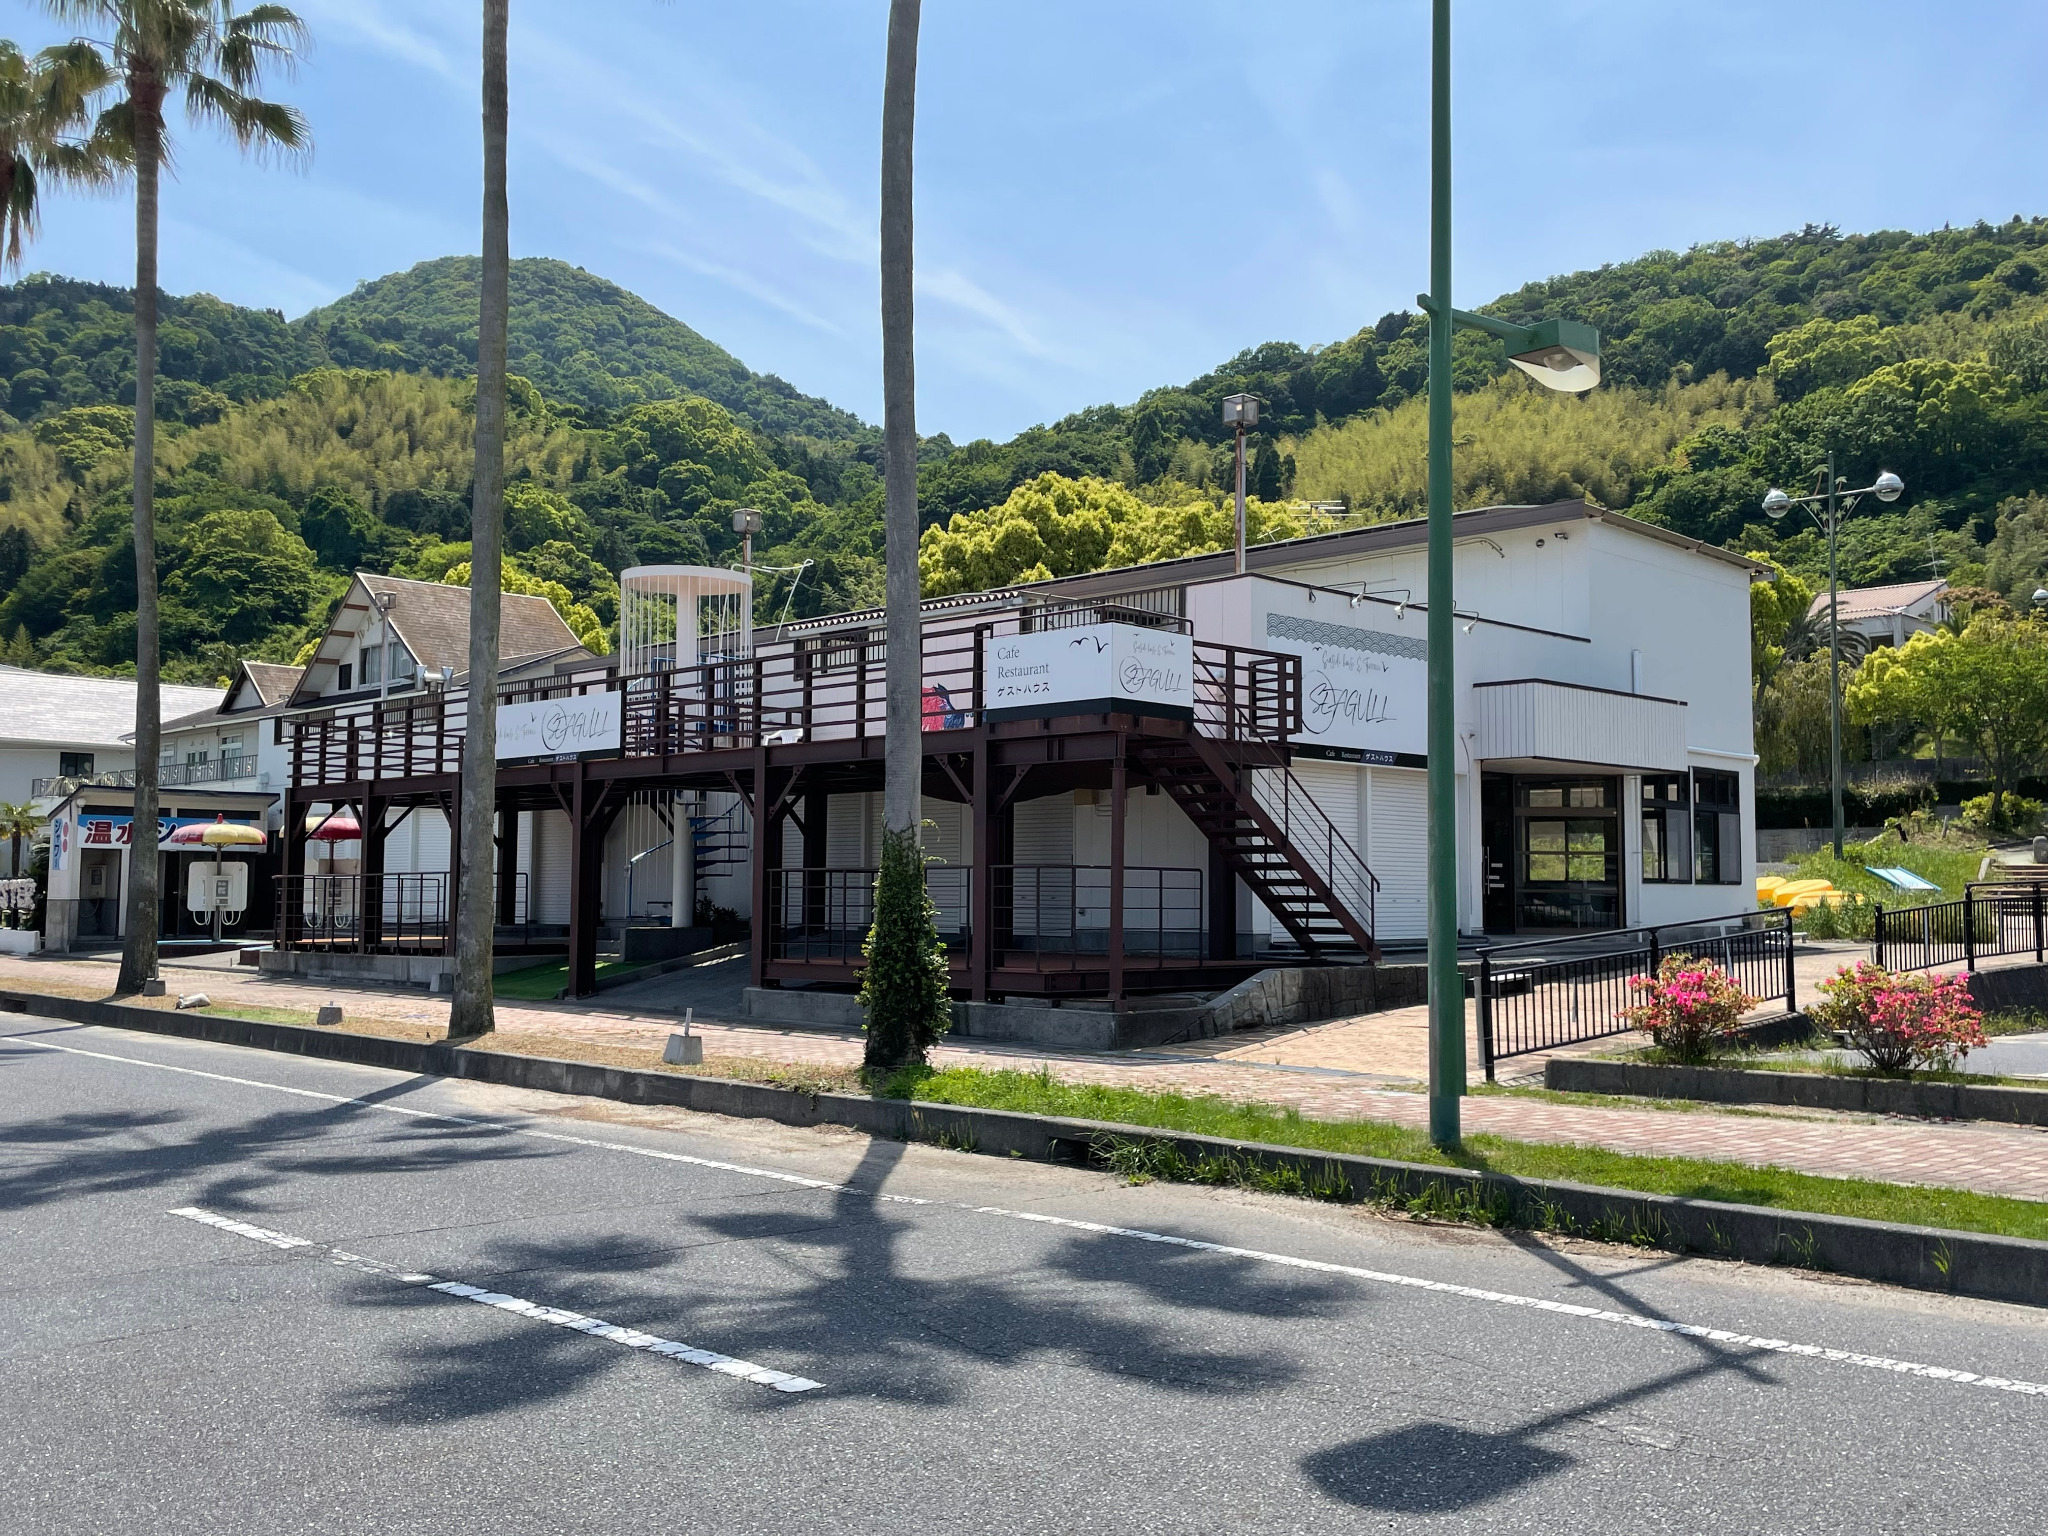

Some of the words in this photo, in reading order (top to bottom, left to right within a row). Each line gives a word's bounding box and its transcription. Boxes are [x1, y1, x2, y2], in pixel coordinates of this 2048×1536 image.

[998, 645, 1020, 660] Cafe
[997, 663, 1050, 679] Restaurant
[1124, 663, 1188, 693] SEAGULL
[997, 682, 1050, 697] ゲストハウス
[1308, 682, 1398, 727] SEAGULL
[545, 707, 615, 743] SEAGULL
